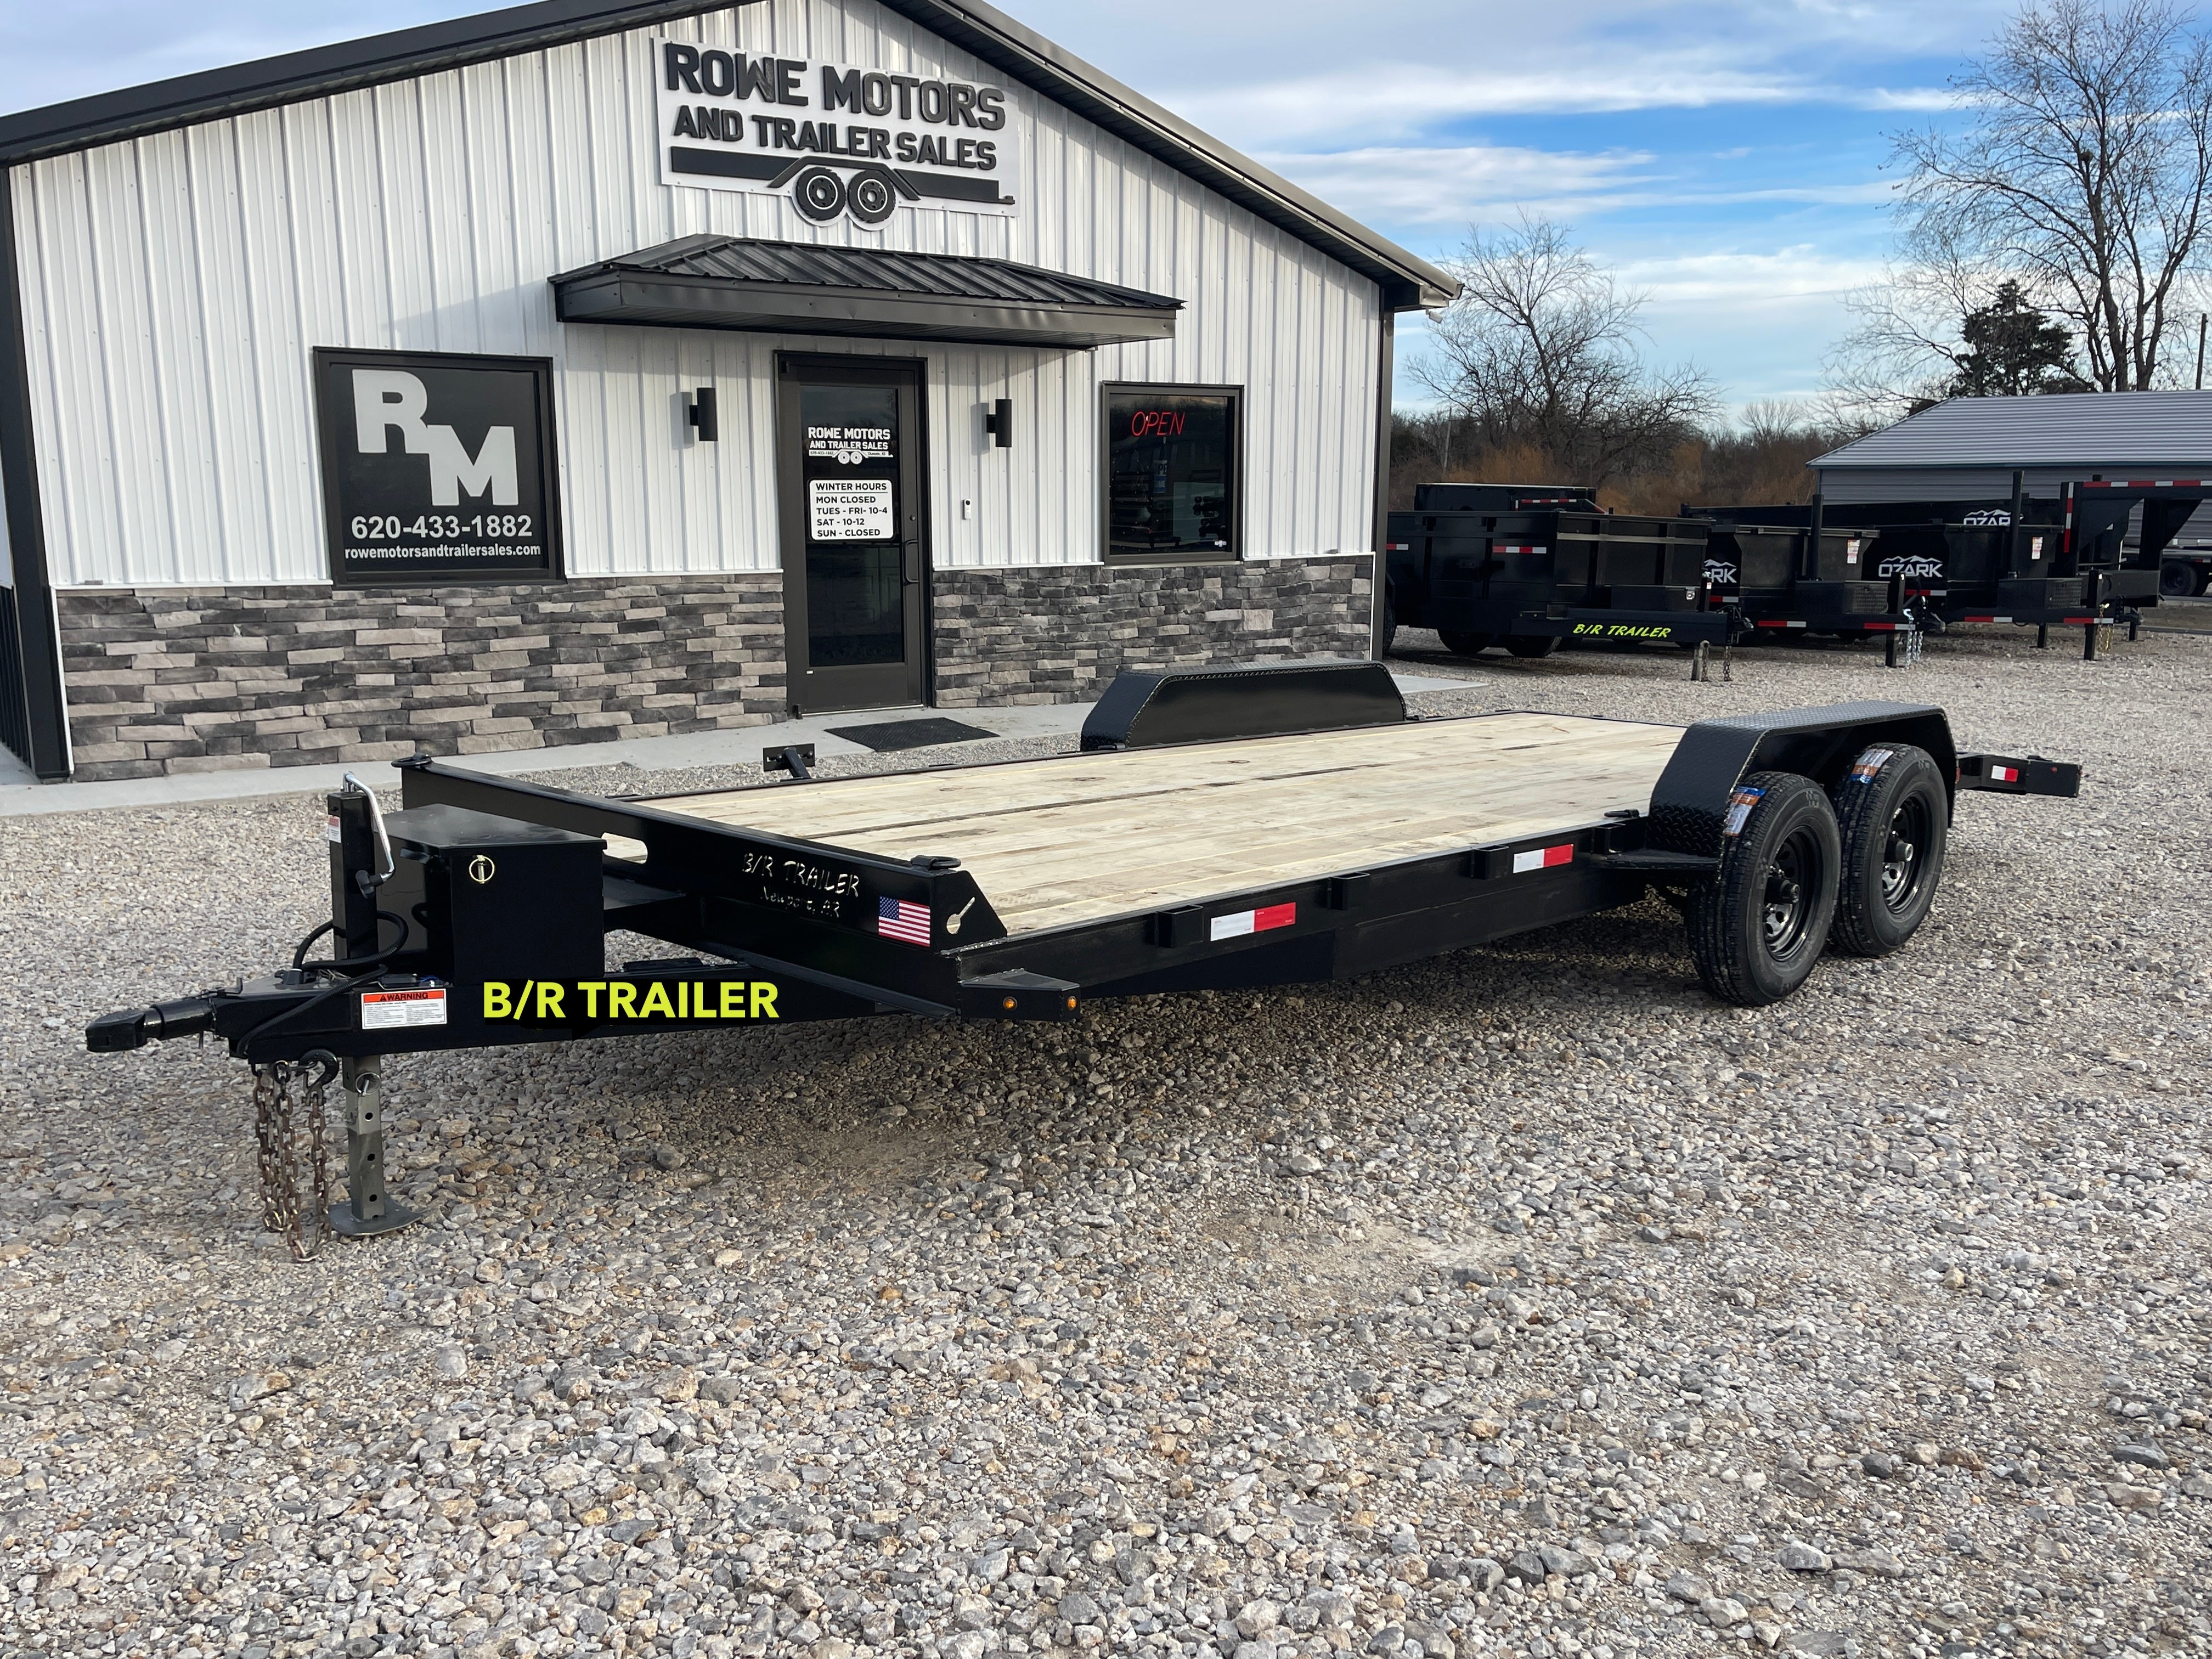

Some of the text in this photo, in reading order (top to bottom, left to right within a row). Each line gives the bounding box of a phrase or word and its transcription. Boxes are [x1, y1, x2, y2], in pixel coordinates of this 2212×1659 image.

[665, 42, 1006, 130] ROWE MOTORS
[674, 105, 997, 170] AND TRAILER SALES
[1131, 411, 1185, 436] OPEN
[352, 369, 519, 506] RM
[808, 427, 890, 440] ROWE MOTORS
[810, 440, 888, 450] AND TRAILER SALES
[351, 515, 533, 539] 620-433-1882
[1963, 516, 2024, 527] OZAR
[345, 543, 541, 559] rowemotorsandtrailersales.com
[1878, 563, 1943, 578] OZARK
[1572, 623, 1672, 638] B/R TRAILER
[741, 852, 860, 898] B/R TRAILER
[387, 992, 428, 1001] WARNING
